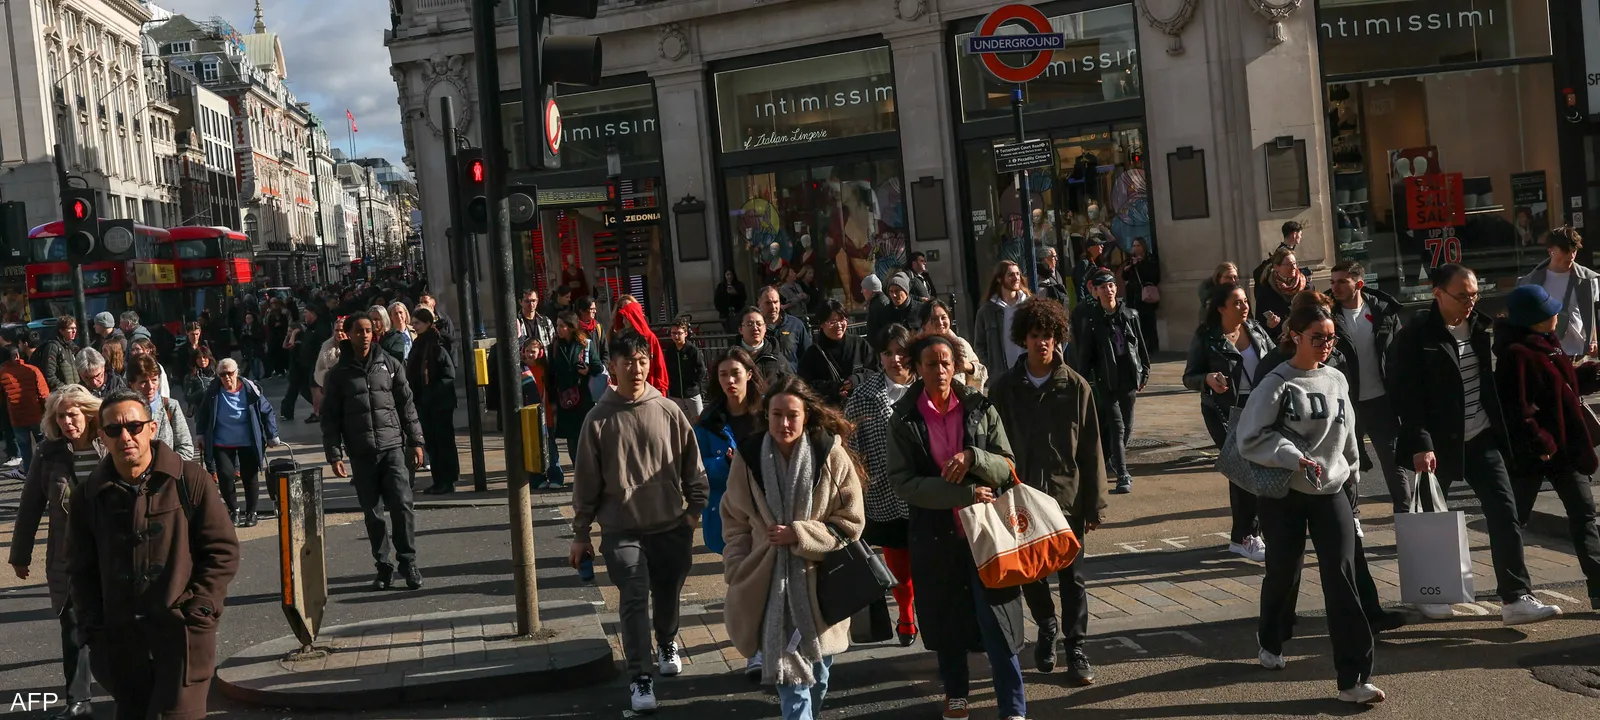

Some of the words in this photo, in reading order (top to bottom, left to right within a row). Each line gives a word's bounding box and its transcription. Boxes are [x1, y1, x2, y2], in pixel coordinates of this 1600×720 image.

[973, 36, 1060, 50] UNDERGROUND
[754, 132, 789, 148] Italian
[790, 127, 827, 143] Lingerie
[609, 213, 660, 223] CZEDONIA
[1428, 228, 1442, 238] UP
[1424, 237, 1462, 268] 70
[1282, 387, 1346, 426] ADA
[1419, 586, 1442, 595] COS
